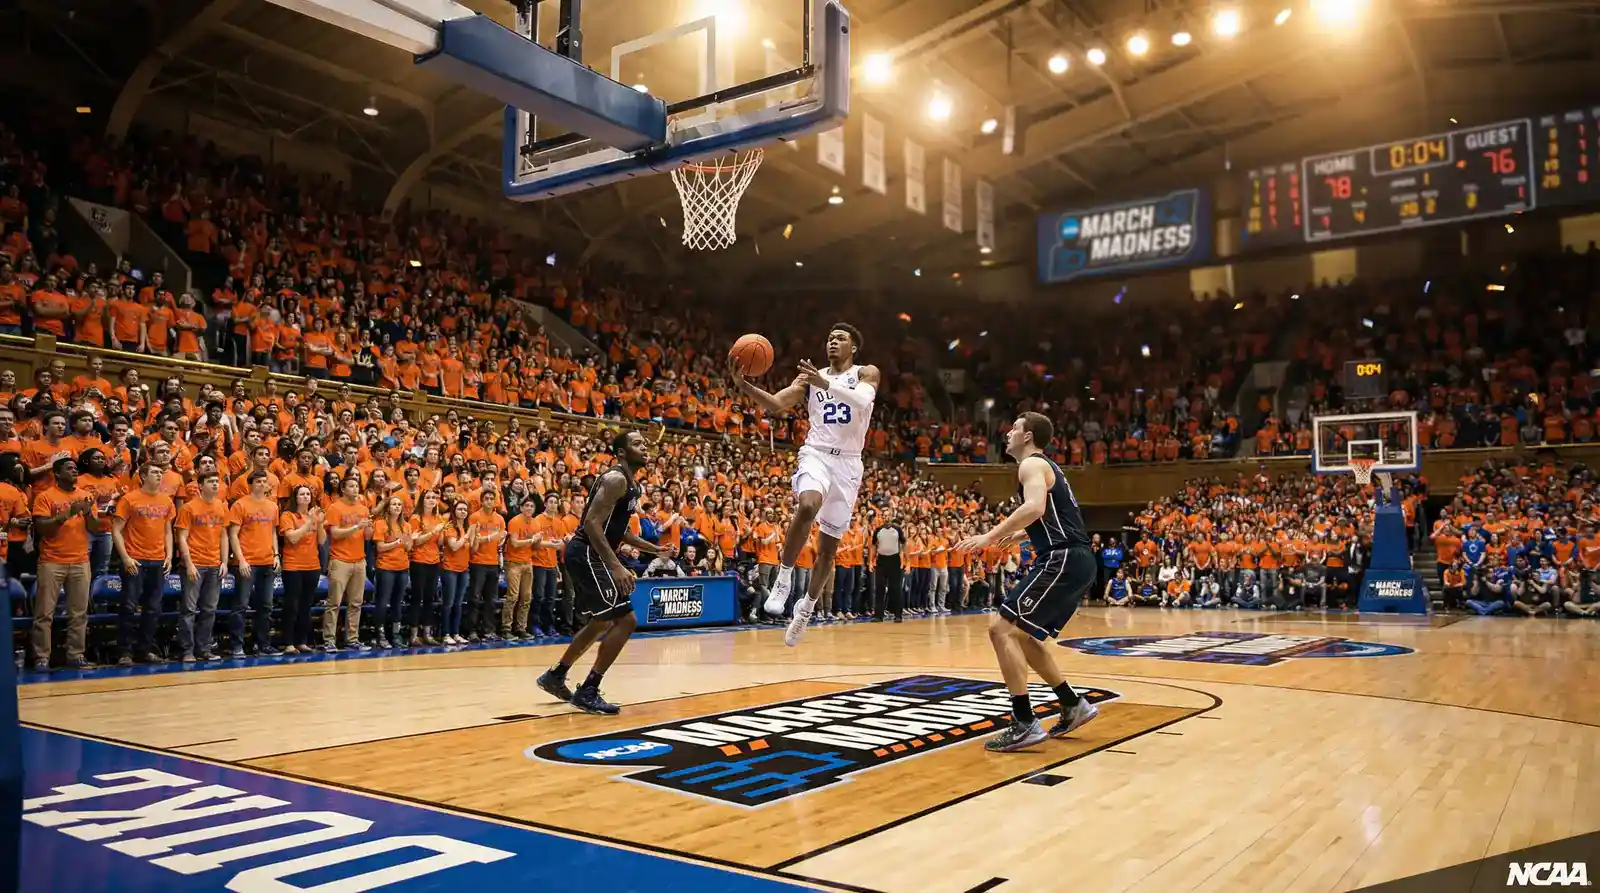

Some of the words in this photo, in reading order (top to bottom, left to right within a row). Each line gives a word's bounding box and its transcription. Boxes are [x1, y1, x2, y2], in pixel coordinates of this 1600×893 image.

[1465, 126, 1520, 149] GUEST
[1314, 156, 1355, 175] HOME
[1389, 139, 1445, 169] 0:04
[1483, 148, 1516, 174] 76
[1324, 176, 1351, 199] 78
[1081, 205, 1155, 238] MARCH
[1090, 224, 1192, 260] MADNESS
[1357, 364, 1381, 376] 0:04
[823, 403, 852, 424] 23
[660, 588, 689, 602] MARCH
[1375, 581, 1401, 589] MARCH
[664, 600, 702, 615] MADNESS
[641, 692, 929, 747] MARCH
